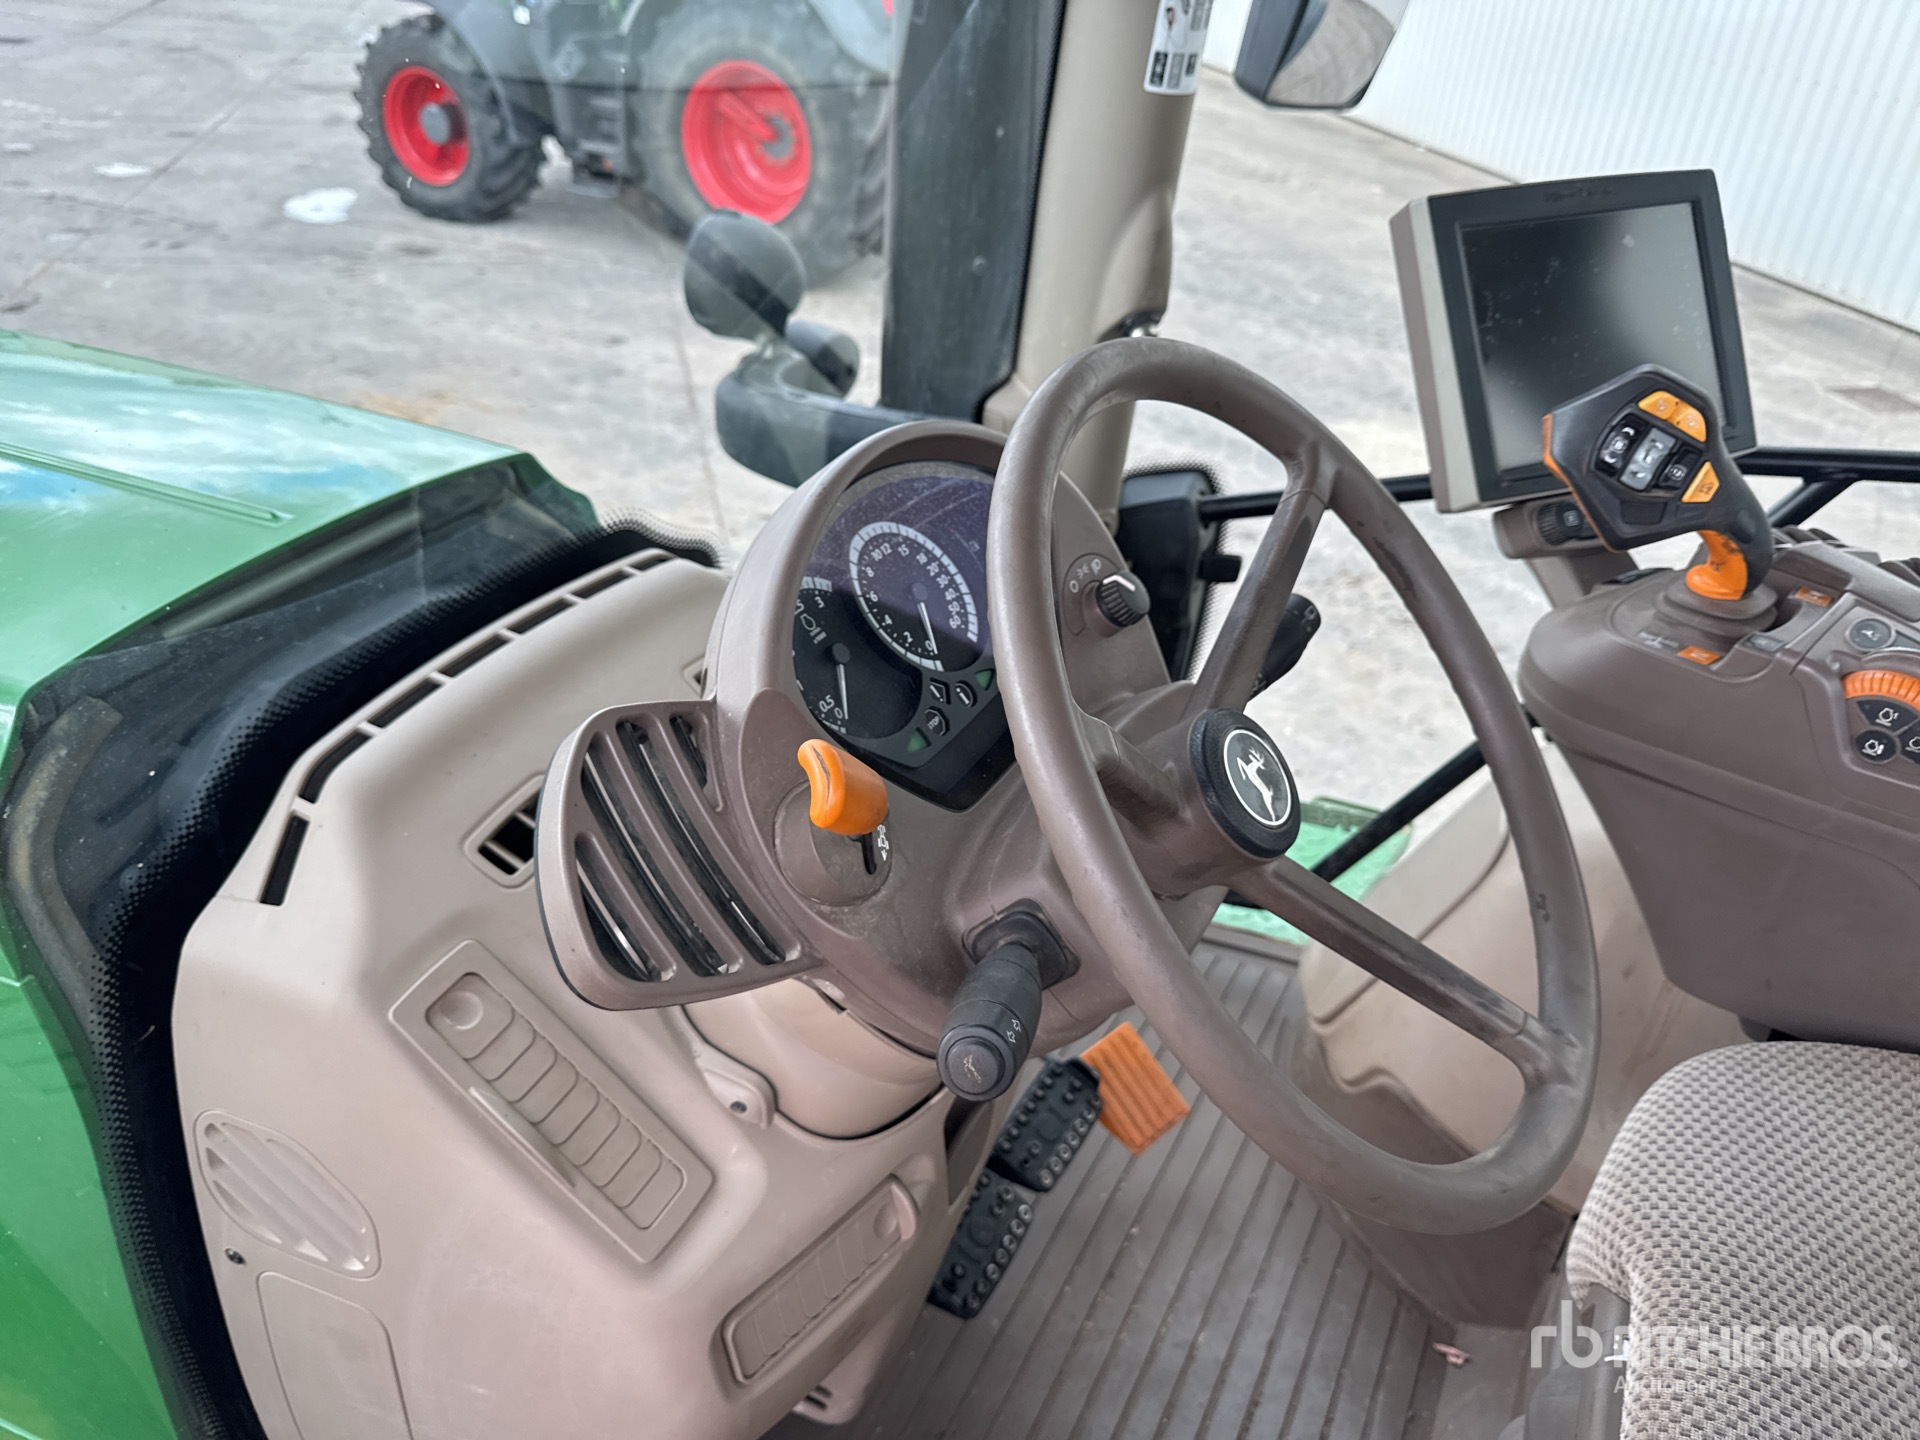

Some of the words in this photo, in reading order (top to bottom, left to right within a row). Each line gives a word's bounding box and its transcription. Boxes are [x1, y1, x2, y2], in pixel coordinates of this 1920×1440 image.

[869, 591, 878, 602] 6
[903, 631, 913, 643] 2
[834, 707, 844, 720] 0
